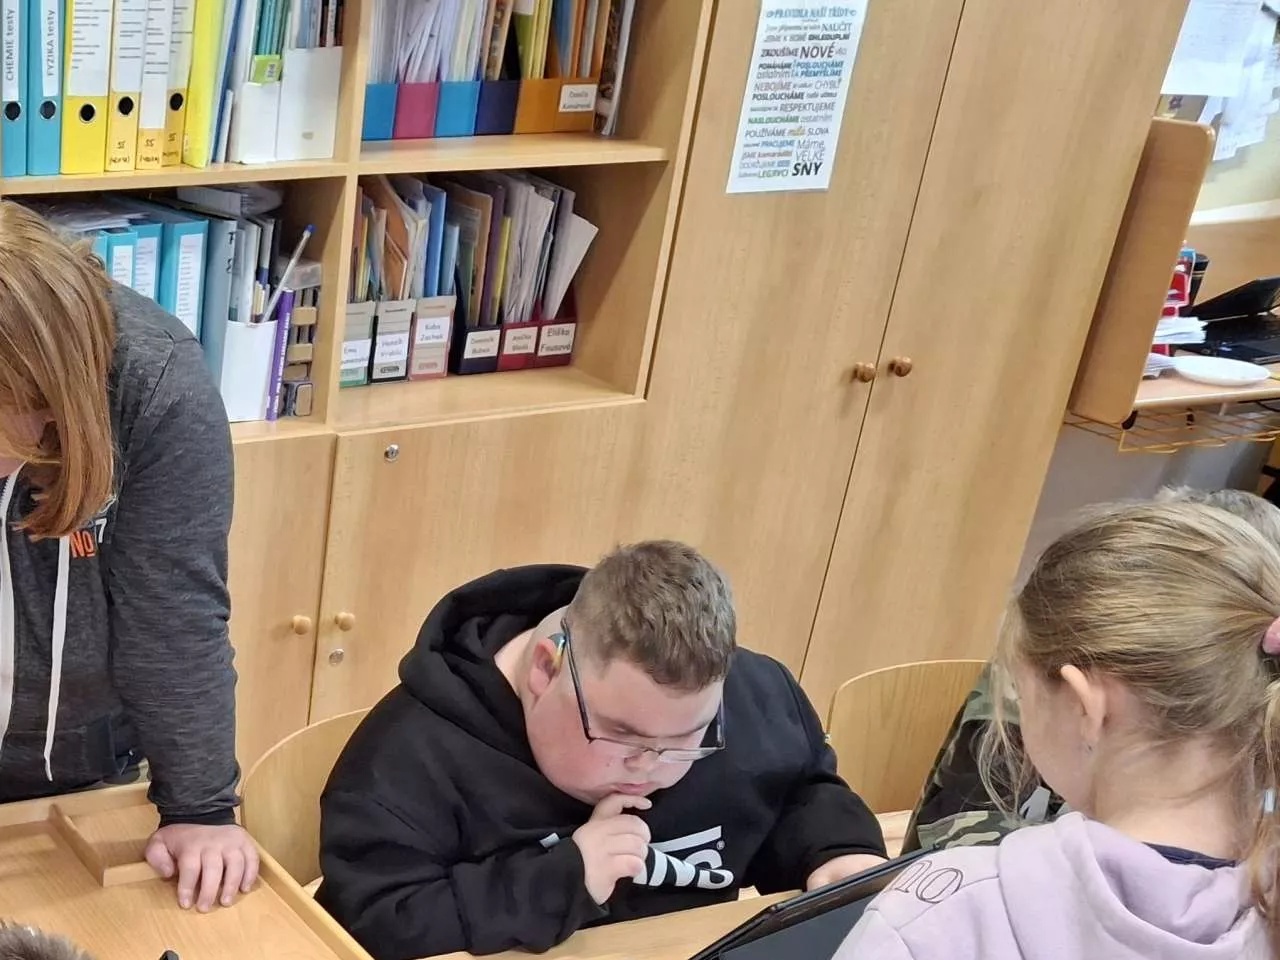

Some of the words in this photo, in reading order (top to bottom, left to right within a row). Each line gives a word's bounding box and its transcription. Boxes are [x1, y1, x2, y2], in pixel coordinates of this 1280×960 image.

[6, 9, 15, 36] testy
[47, 10, 55, 36] testy
[47, 40, 55, 76] FYZIKA
[800, 42, 835, 58] NOVÉ
[6, 40, 15, 81] CHEMIE
[752, 90, 805, 100] POSLOUCHÁME
[780, 102, 836, 112] RESPEKTUJEME
[807, 127, 829, 136] SLOVA
[792, 161, 823, 177] SNY
